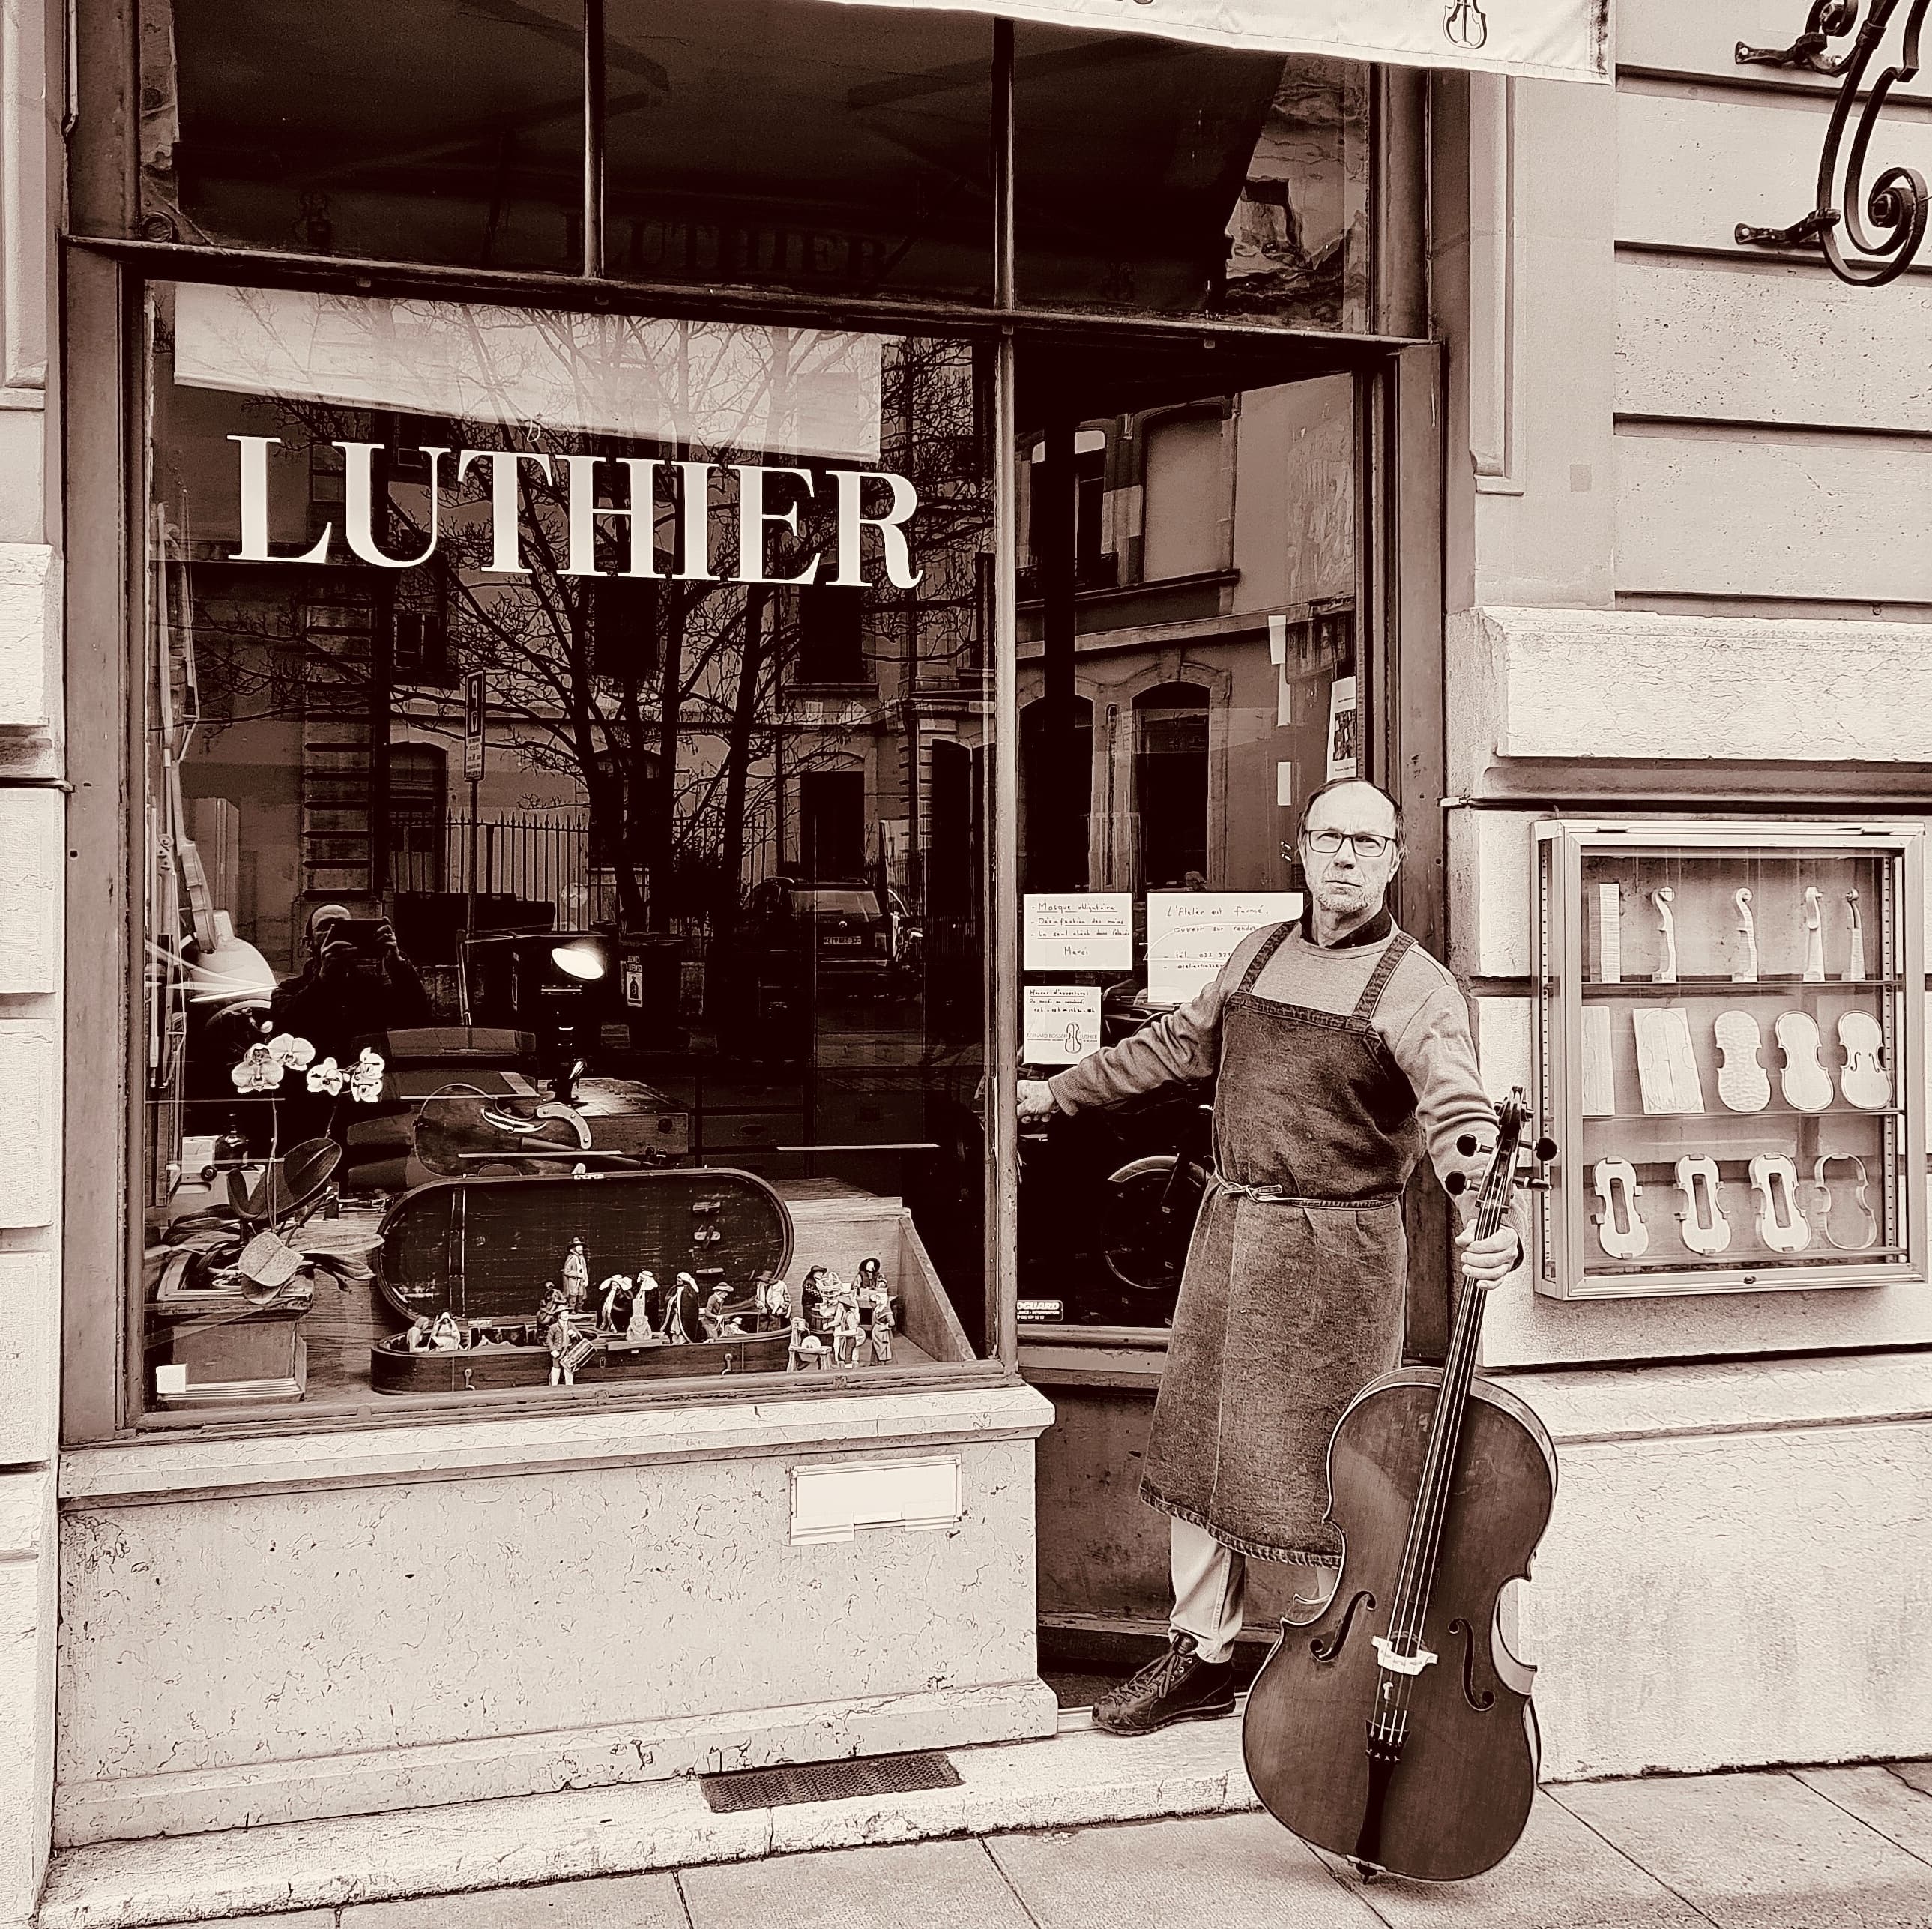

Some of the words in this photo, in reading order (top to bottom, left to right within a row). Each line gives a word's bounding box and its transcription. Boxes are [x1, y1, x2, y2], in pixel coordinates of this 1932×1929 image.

[226, 435, 924, 589] LUTHIER
[1167, 905, 1204, 917] L'Atelier
[1064, 946, 1089, 956] Merci
